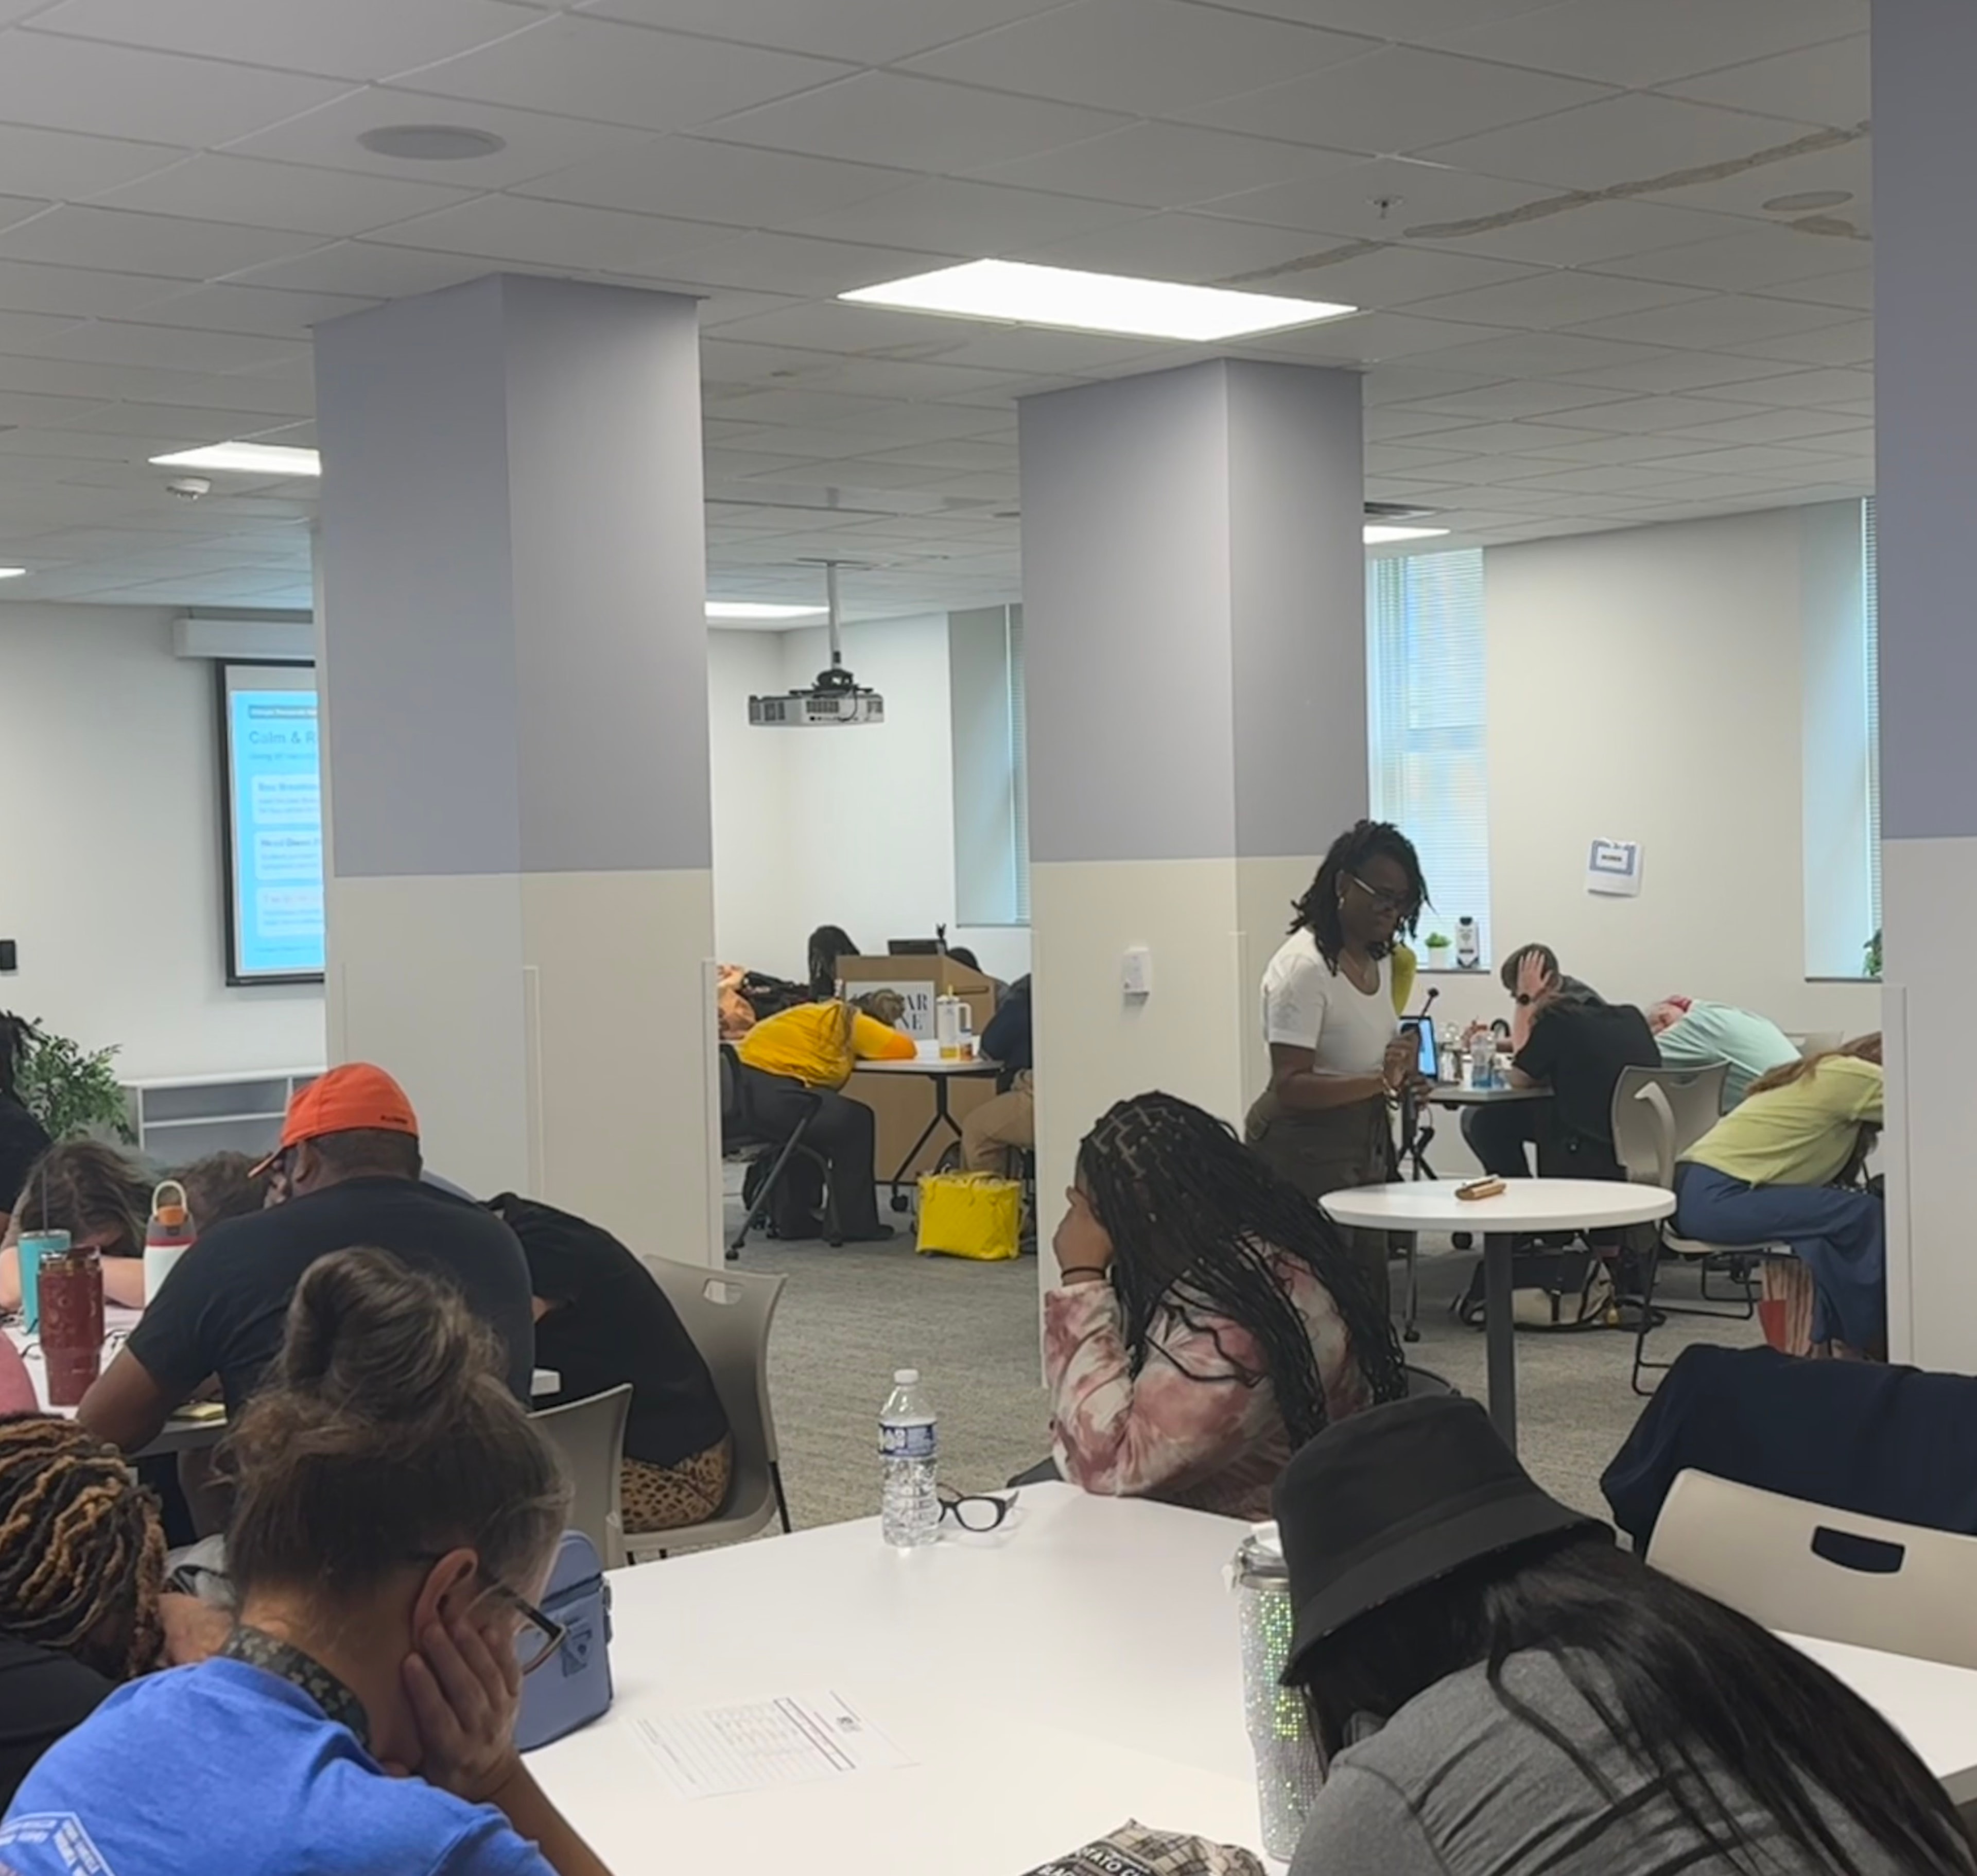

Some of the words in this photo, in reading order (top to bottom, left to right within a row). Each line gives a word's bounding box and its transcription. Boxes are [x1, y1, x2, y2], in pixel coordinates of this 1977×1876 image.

[249, 730, 286, 744] Calm
[290, 730, 301, 744] &
[305, 730, 317, 744] R
[905, 993, 928, 1011] AR
[898, 1013, 924, 1030] NE
